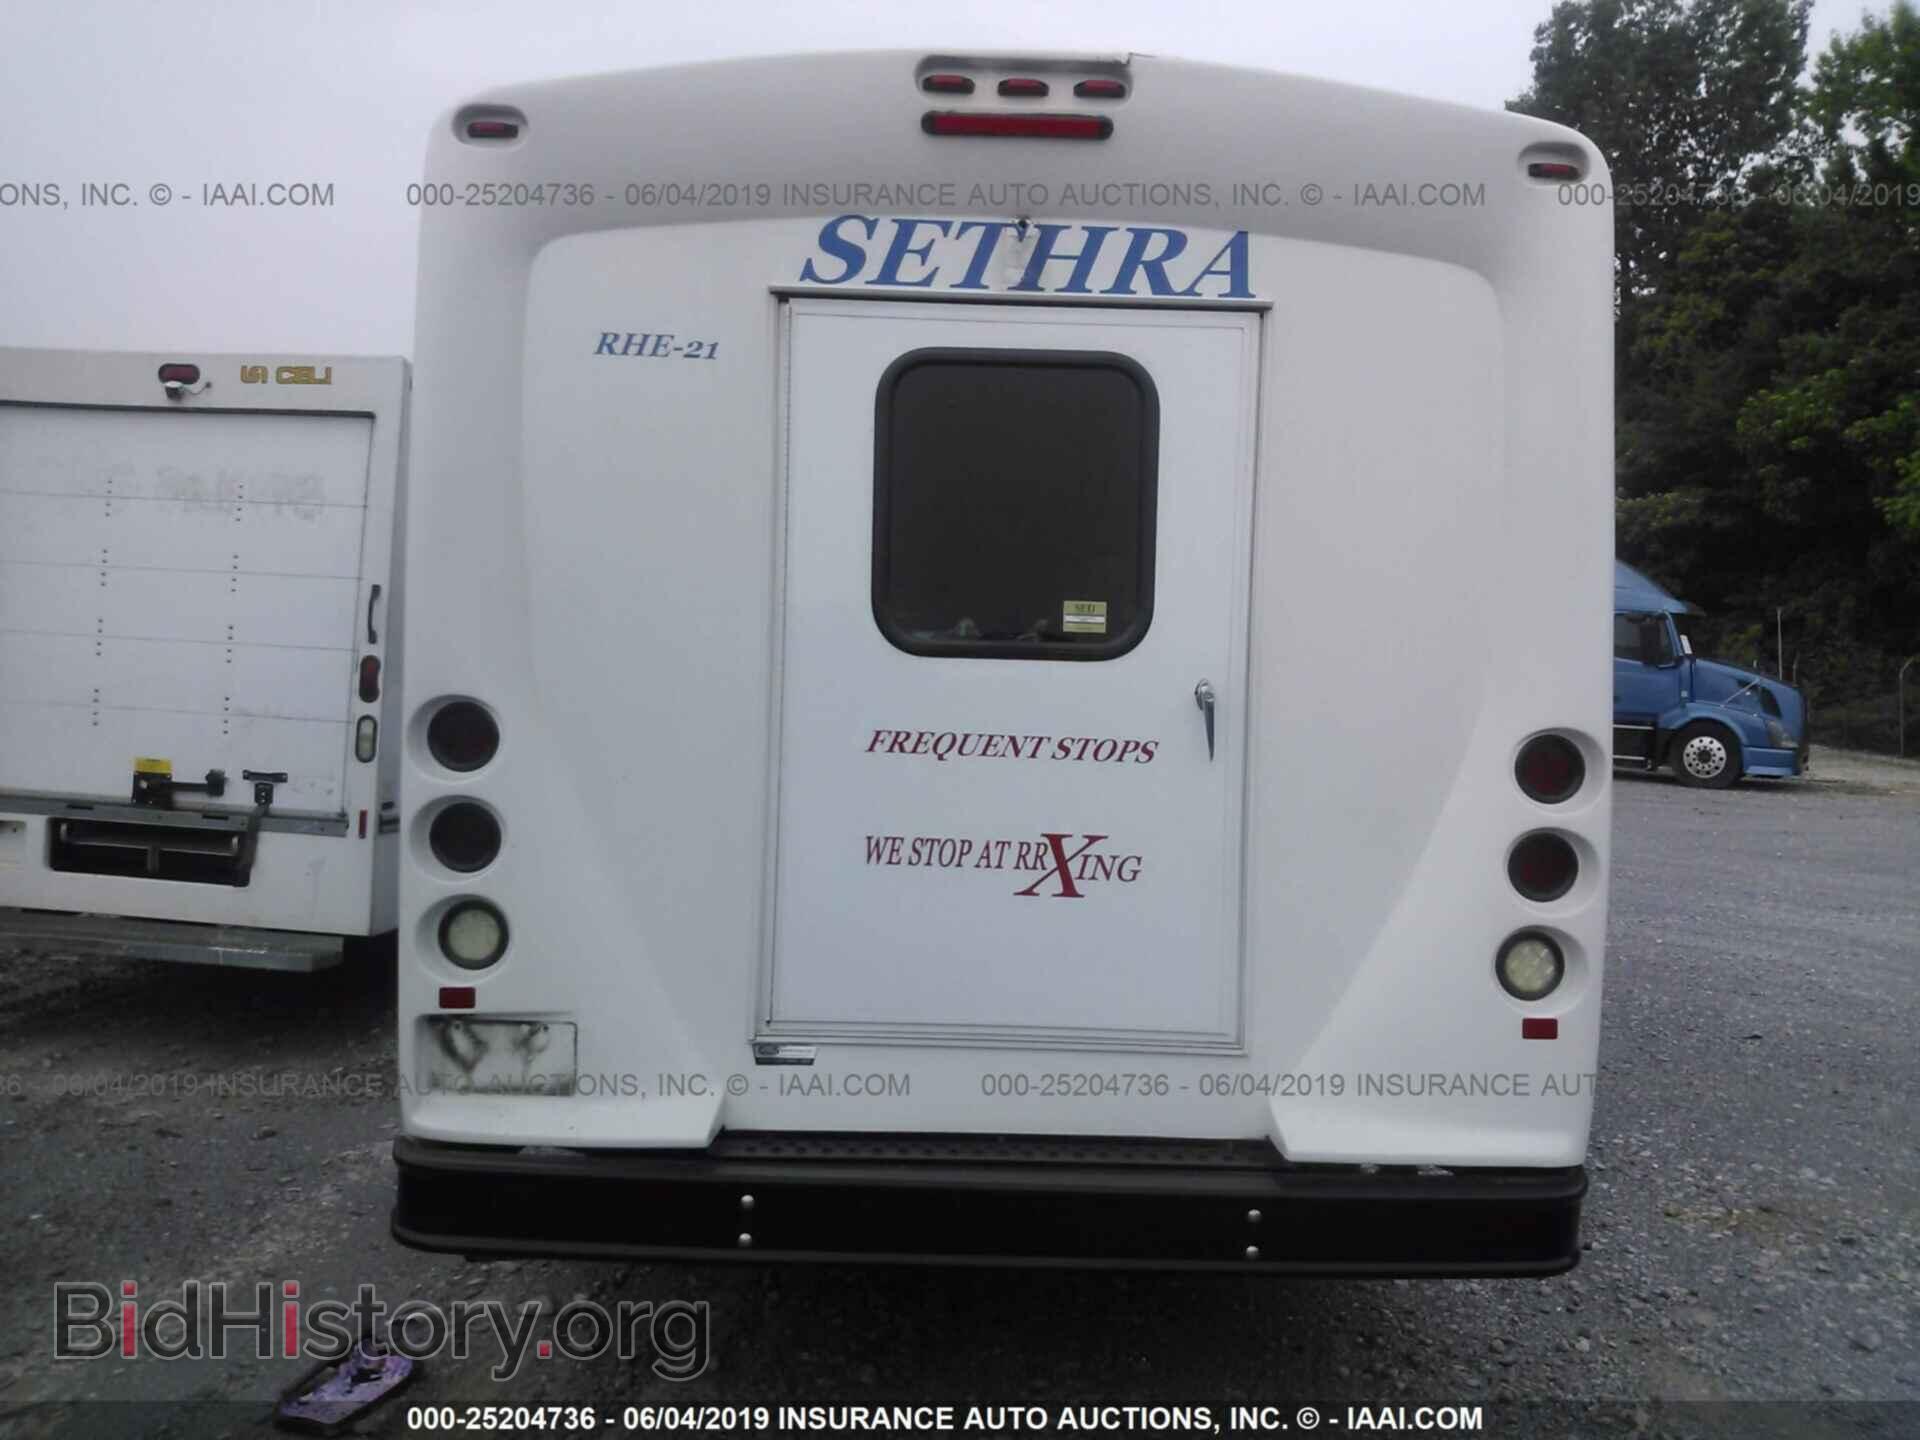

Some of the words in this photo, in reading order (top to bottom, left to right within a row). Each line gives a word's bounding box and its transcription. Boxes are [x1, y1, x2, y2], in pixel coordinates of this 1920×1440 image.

[800, 215, 1257, 299] SETHRA
[594, 331, 719, 360] RHE-21
[865, 729, 1050, 761] FREQUENT
[1051, 736, 1159, 764] STOPS
[865, 835, 904, 866] WE
[908, 836, 973, 868] STOP
[974, 840, 1012, 869] AT
